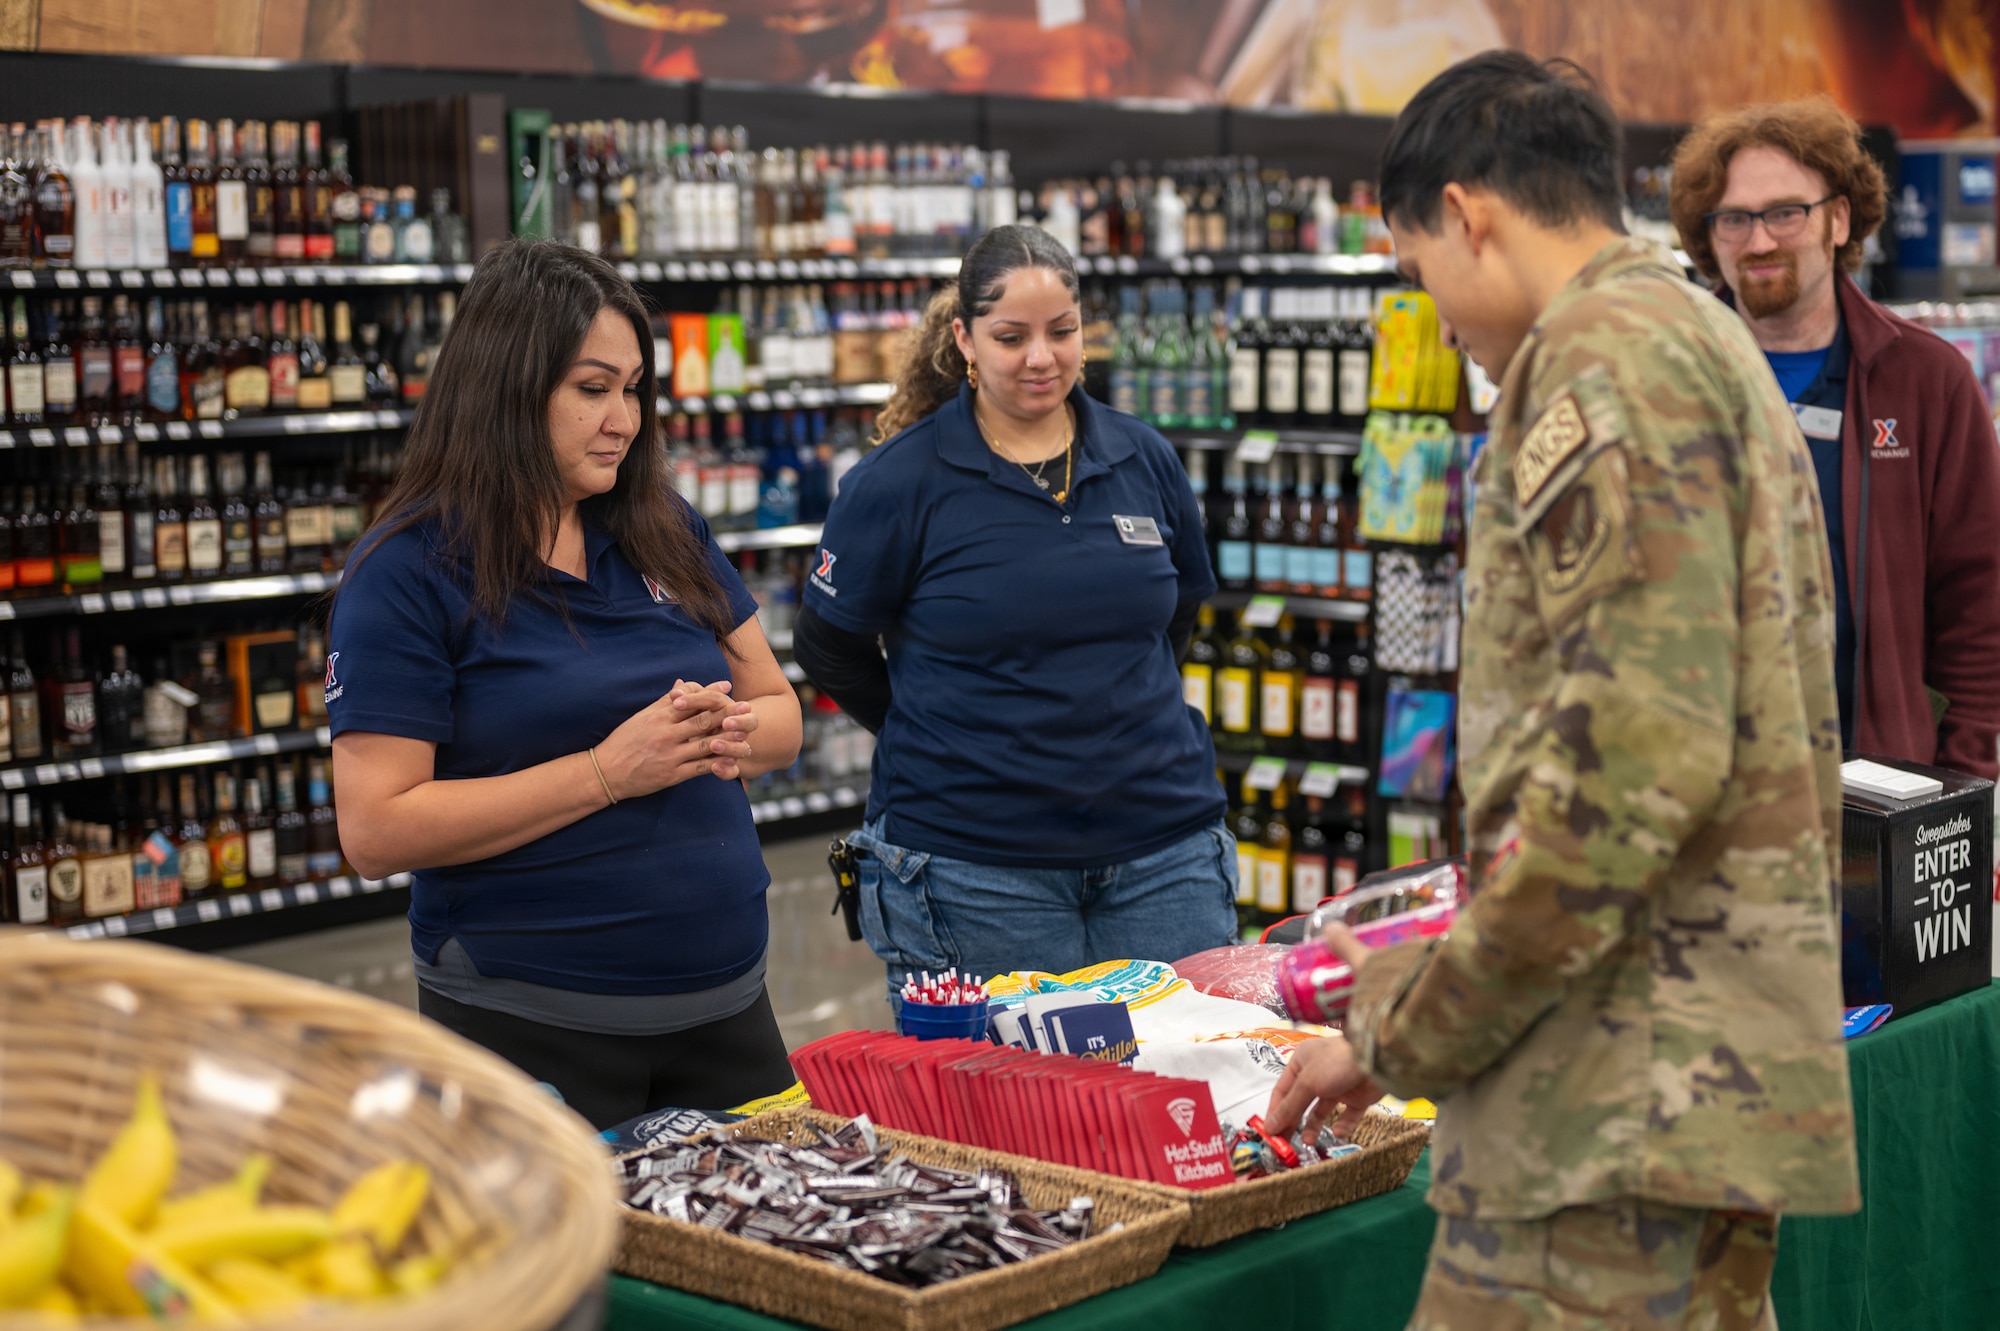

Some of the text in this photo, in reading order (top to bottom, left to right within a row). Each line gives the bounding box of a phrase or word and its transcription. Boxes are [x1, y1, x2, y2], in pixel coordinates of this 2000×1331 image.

[1915, 812, 1972, 847] Sweepstakes
[1914, 838, 1971, 884] ENTER
[1914, 903, 1971, 964] WIN
[1080, 1037, 1137, 1062] Miller
[1087, 1035, 1107, 1050] IT'S
[1173, 1160, 1225, 1183] Kitchen
